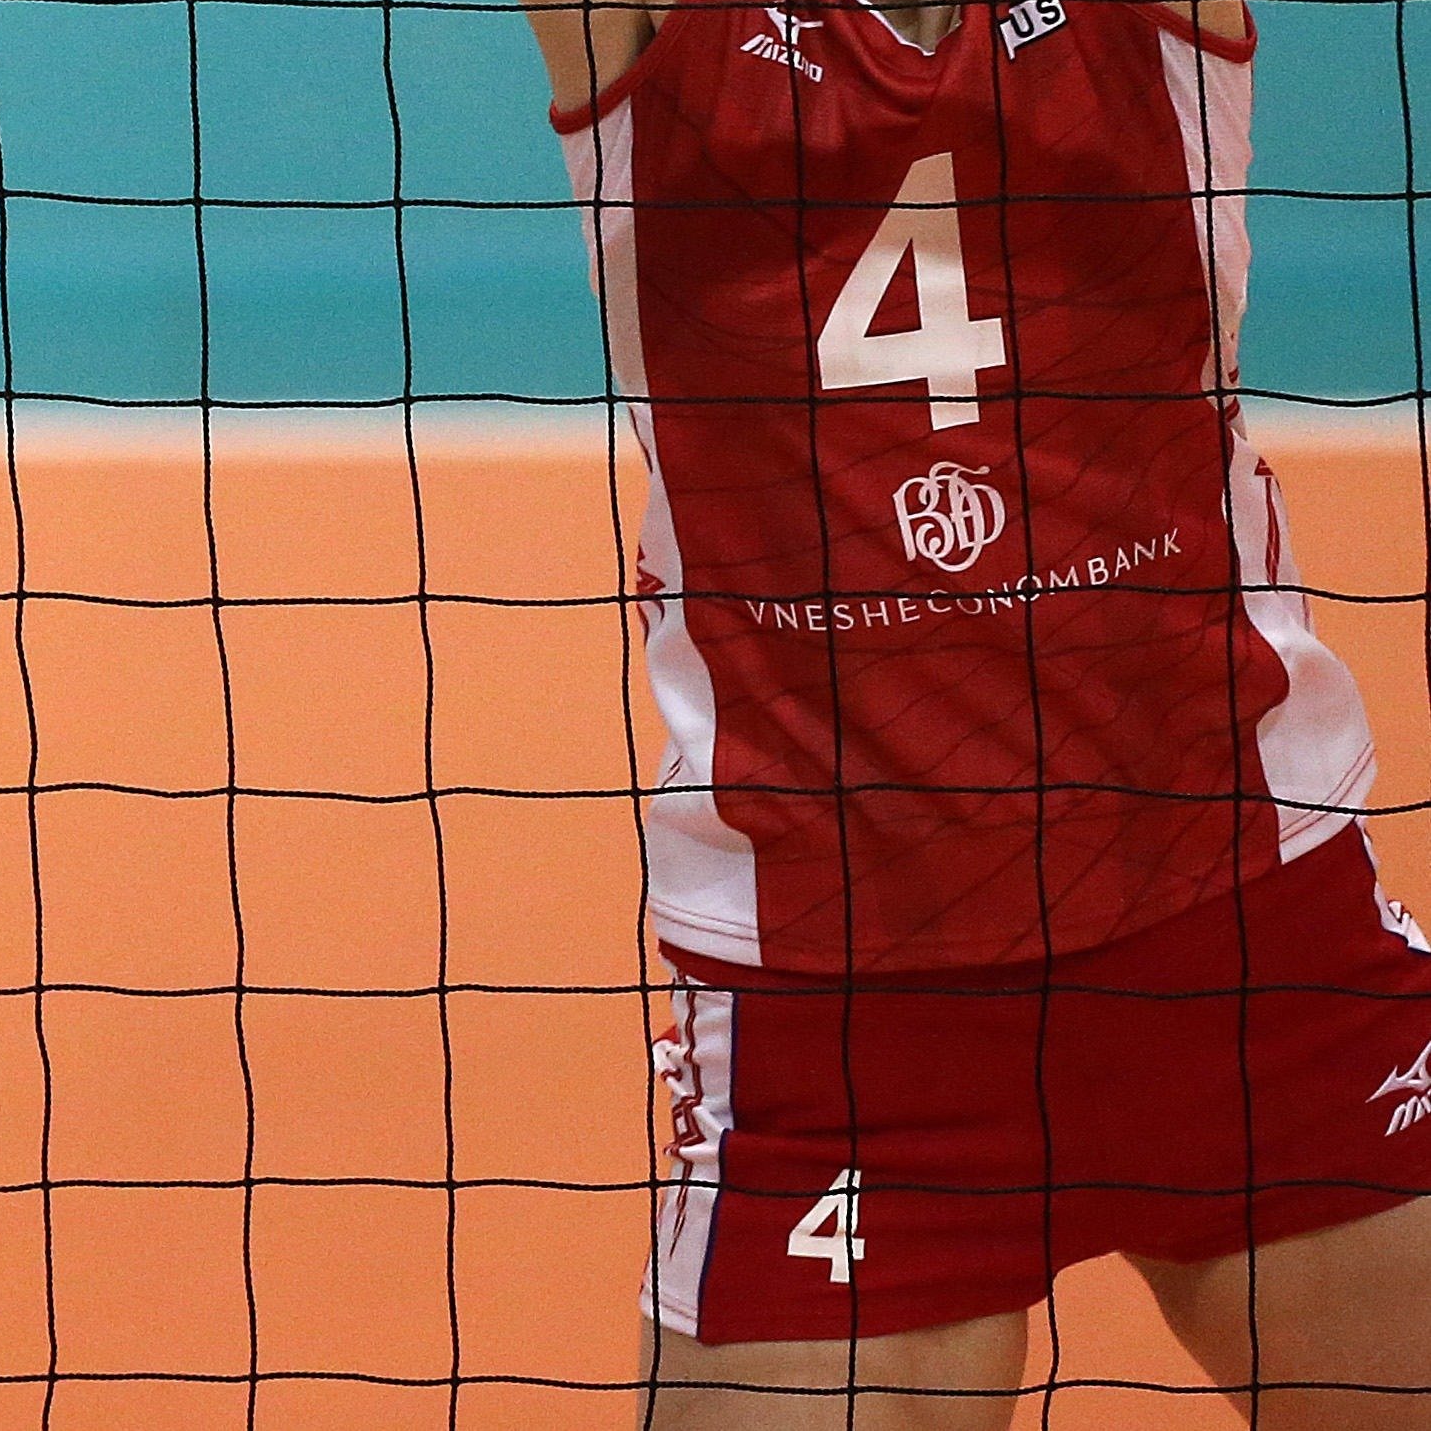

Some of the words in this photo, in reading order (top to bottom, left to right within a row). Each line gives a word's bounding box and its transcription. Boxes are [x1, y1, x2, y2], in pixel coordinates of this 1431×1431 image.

[817, 151, 1006, 430] 4
[745, 528, 1182, 632] VNESHECONOMBANK
[786, 1168, 866, 1284] 4
